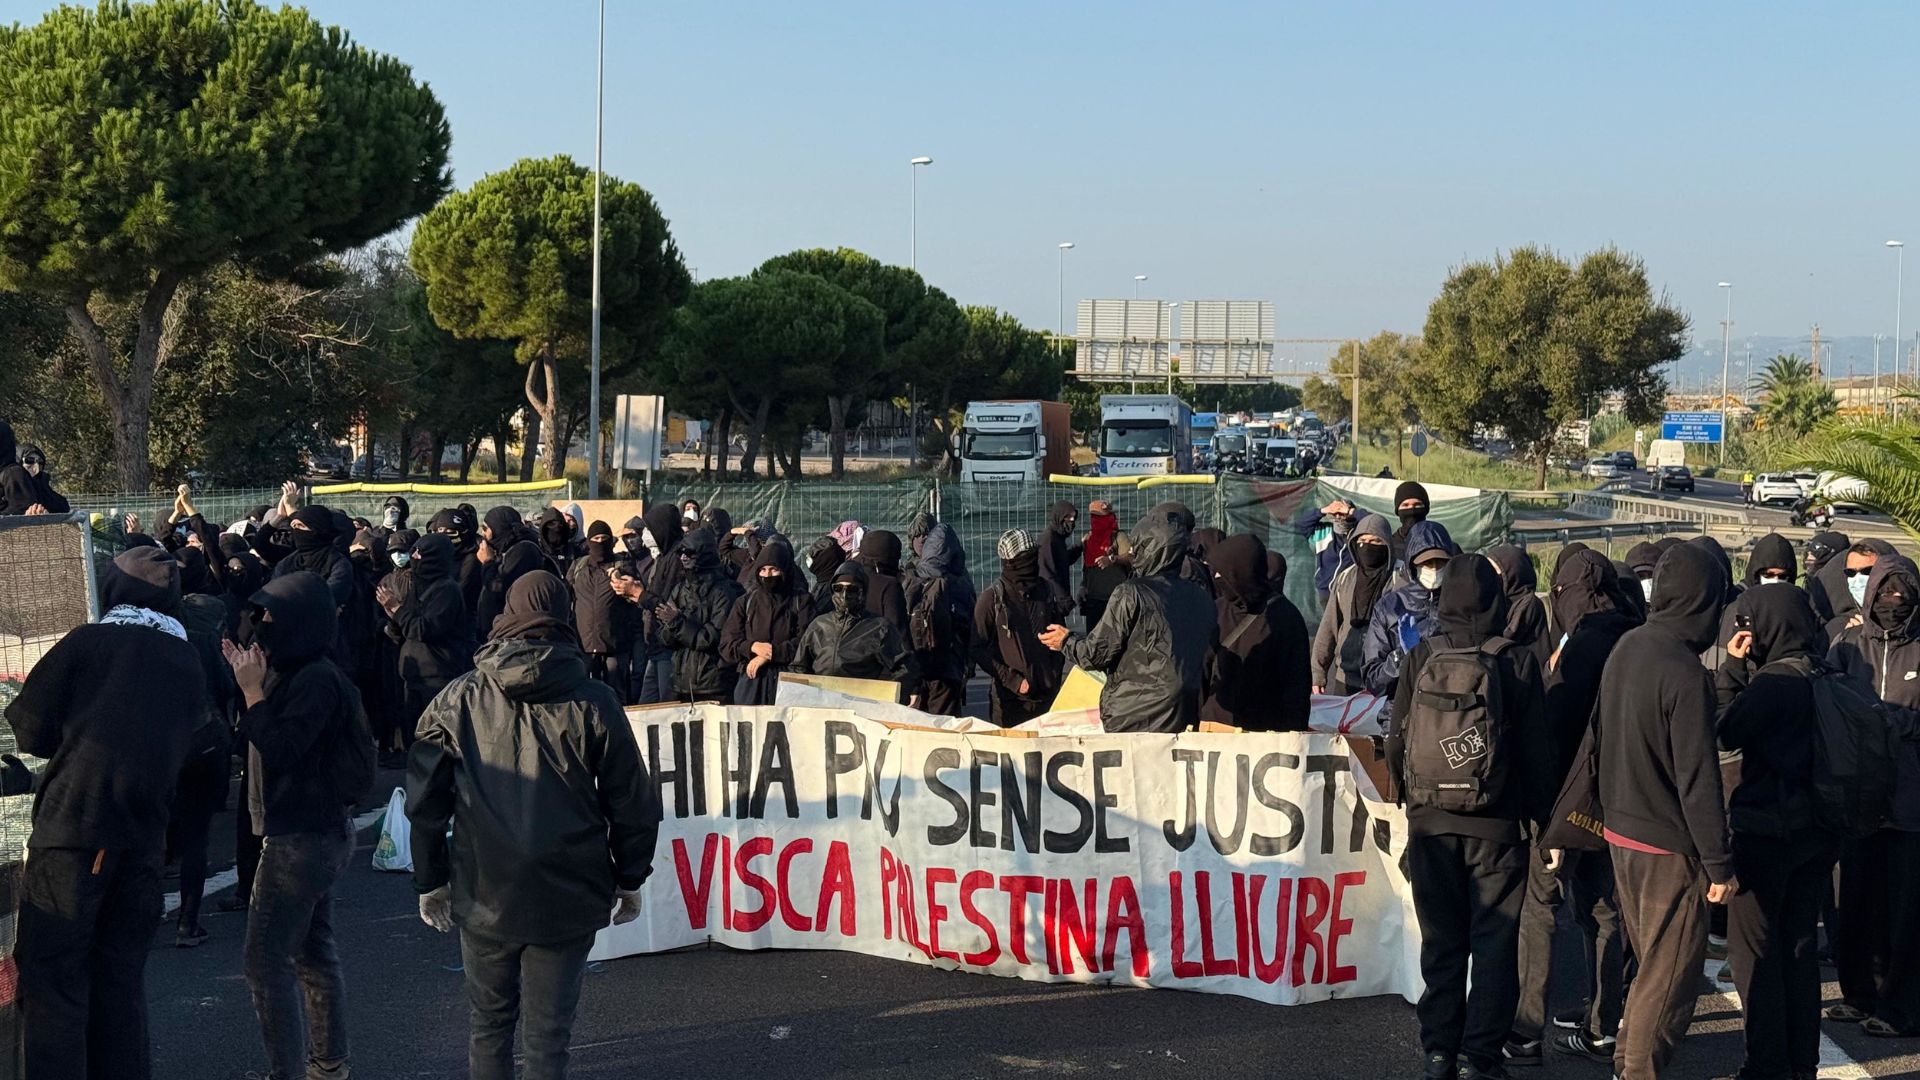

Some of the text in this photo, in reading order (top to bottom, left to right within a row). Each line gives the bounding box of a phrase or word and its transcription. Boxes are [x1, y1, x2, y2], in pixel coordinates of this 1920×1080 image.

[720, 720, 799, 820] HA
[923, 747, 1131, 854] SENSE
[672, 832, 856, 937] VISCA
[1169, 870, 1367, 988] LLIURE
